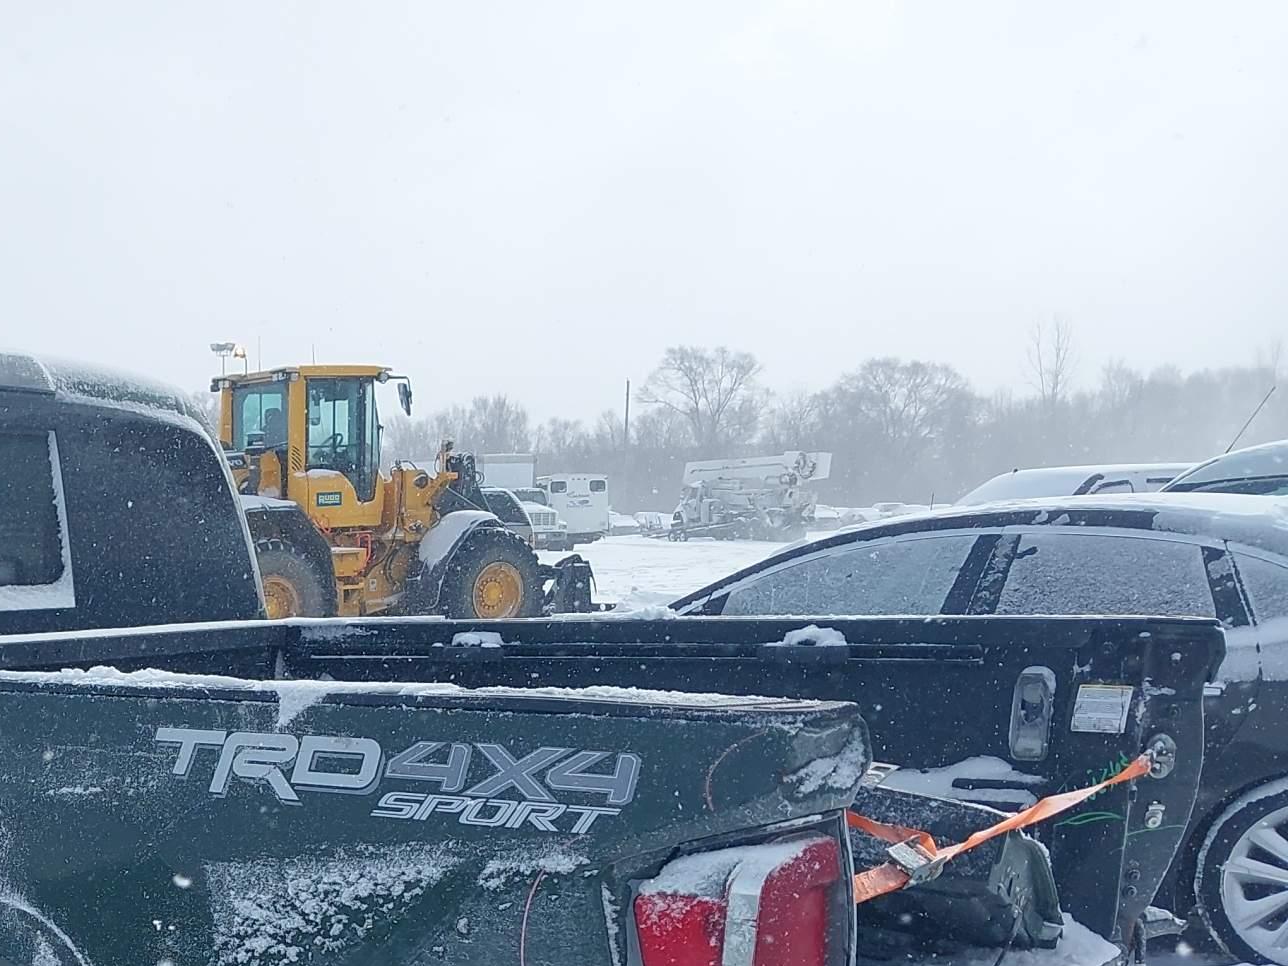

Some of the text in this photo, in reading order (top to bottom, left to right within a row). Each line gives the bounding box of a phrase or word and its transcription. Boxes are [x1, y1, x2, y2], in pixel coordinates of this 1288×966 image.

[155, 728, 642, 806] TRD 4X4
[370, 792, 621, 834] SPORT
